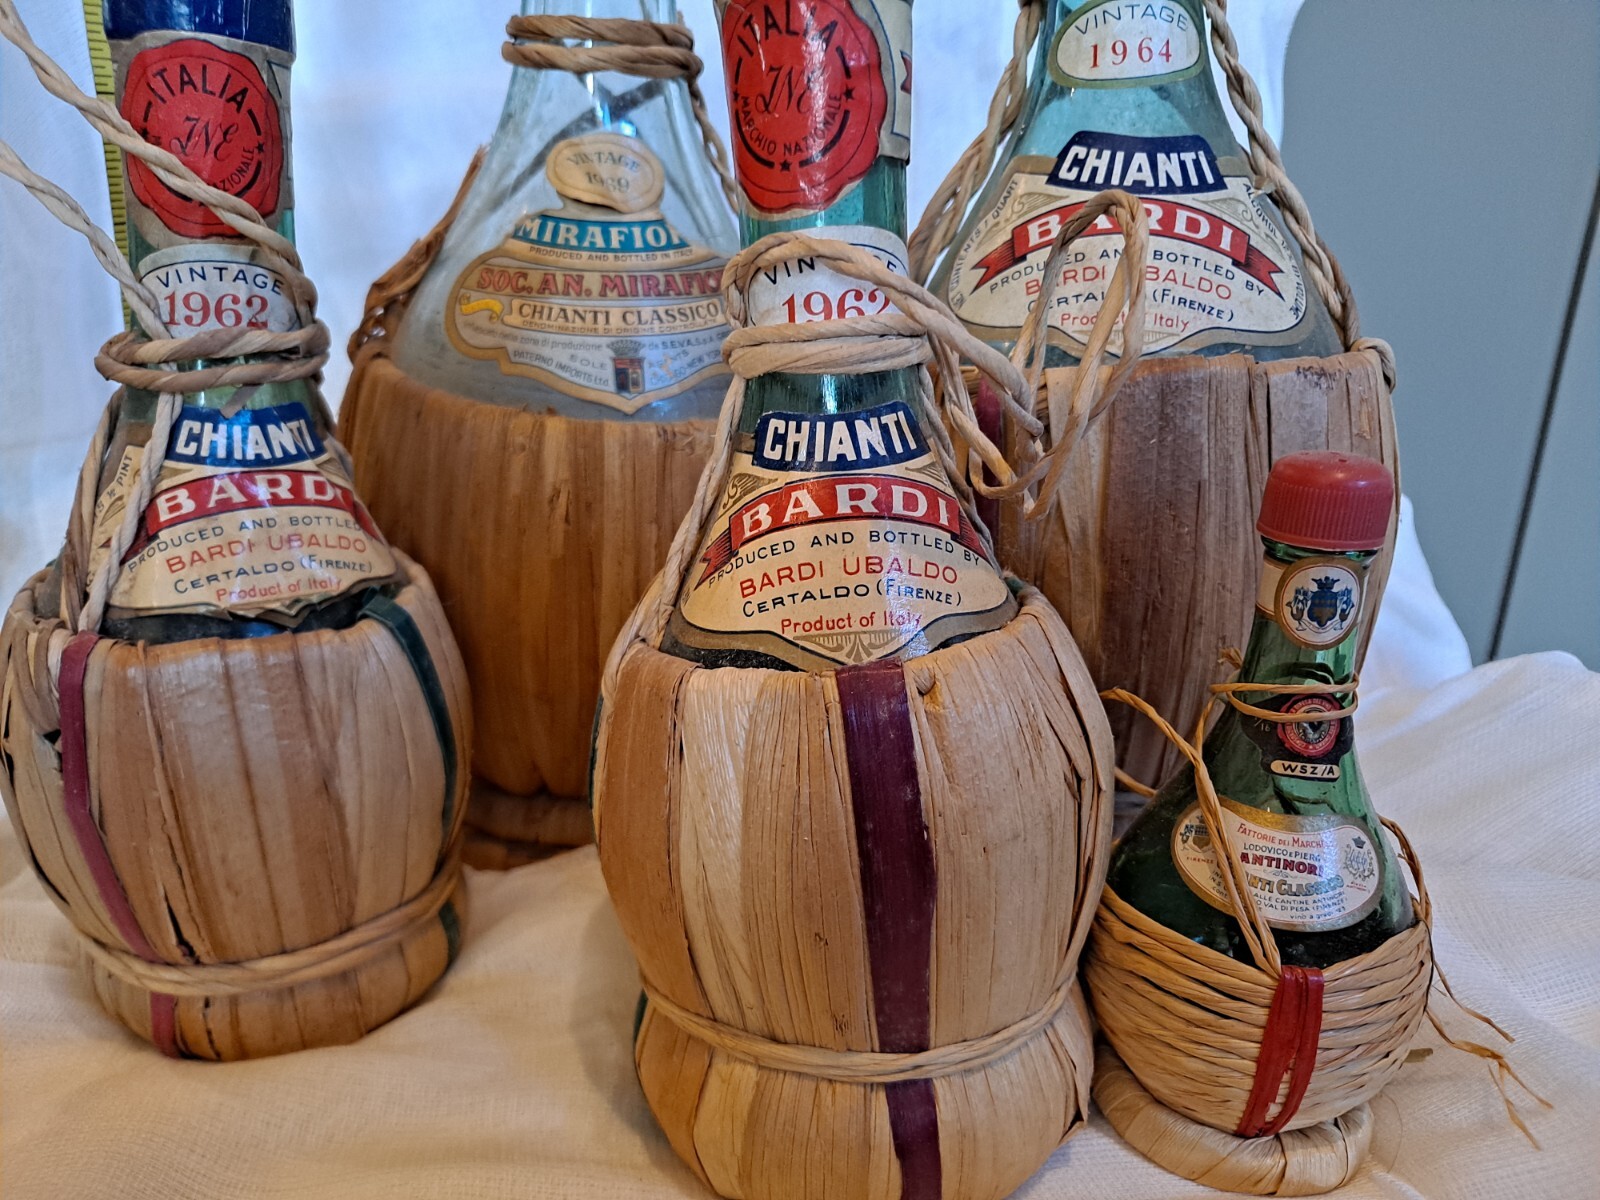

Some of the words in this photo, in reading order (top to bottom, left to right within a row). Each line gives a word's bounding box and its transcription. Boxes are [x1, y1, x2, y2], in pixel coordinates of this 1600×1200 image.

[737, 1, 839, 58] ITALIA
[1075, 4, 1188, 34] VINTAGE
[1090, 37, 1172, 68] 1964
[146, 63, 249, 113] ITALIA
[741, 96, 777, 155] MARCHIO
[566, 151, 640, 173] VINTAGE
[1058, 146, 1216, 188] CHIANTI
[992, 180, 1019, 220] QUART
[529, 245, 582, 261] PRODUCED
[587, 254, 609, 262] AND
[614, 252, 657, 263] BOTTLED
[661, 251, 670, 259] IN
[673, 248, 694, 259] ITALY
[155, 266, 285, 297] VINTAGE
[476, 267, 533, 295] SOC.
[537, 272, 593, 298] AN.
[1024, 264, 1106, 297] BRDI
[1144, 265, 1233, 300] BALDO
[1152, 249, 1236, 281] BOTTLED
[1245, 279, 1265, 296] BY
[163, 290, 270, 329] 1962
[518, 301, 611, 326] CHIANTI
[622, 301, 719, 327] CLASSICO
[1153, 311, 1190, 333] Italy
[175, 418, 316, 461] CHIANTI
[763, 410, 918, 463] CHIANTI
[115, 454, 133, 487] PINT
[742, 482, 950, 540] BARDI
[127, 525, 225, 573] PRODUCED
[238, 516, 278, 532] AND
[165, 538, 253, 574] BARDI
[268, 533, 367, 554] UBALDO
[708, 539, 796, 589] PRODUCED
[810, 531, 855, 548] AND
[869, 530, 954, 554] BOTTLED
[963, 549, 980, 566] BY
[216, 581, 281, 602] Product
[287, 579, 302, 593] of
[307, 577, 343, 592] Italy
[739, 560, 824, 598] BARDI
[842, 555, 958, 584] UBALDO
[781, 612, 853, 635] Product
[859, 611, 876, 627] of
[884, 608, 923, 629] Italy
[1237, 823, 1277, 845] FATTORIE
[1243, 842, 1289, 857] LODOVICO
[1240, 852, 1325, 878] ANTINORI
[1263, 901, 1279, 909] VAL
[1275, 897, 1310, 906] CANTINE
